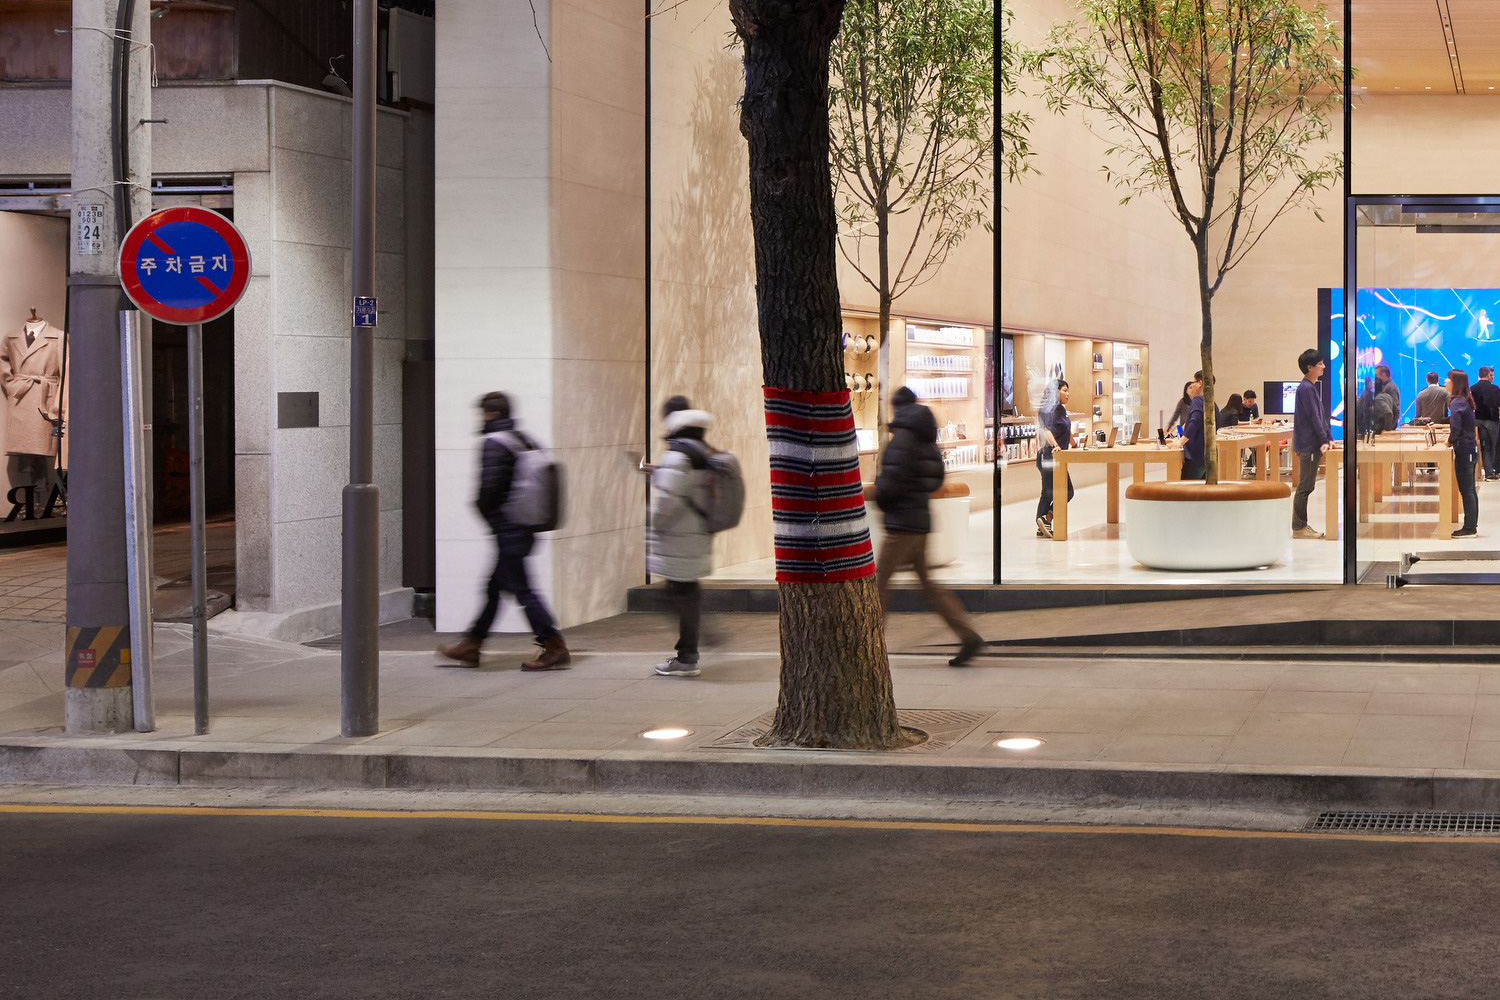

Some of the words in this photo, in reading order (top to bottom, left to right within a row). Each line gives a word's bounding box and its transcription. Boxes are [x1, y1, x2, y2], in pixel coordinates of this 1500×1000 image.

[83, 225, 100, 240] 24
[140, 254, 228, 276] 주차금지
[361, 314, 372, 326] 1
